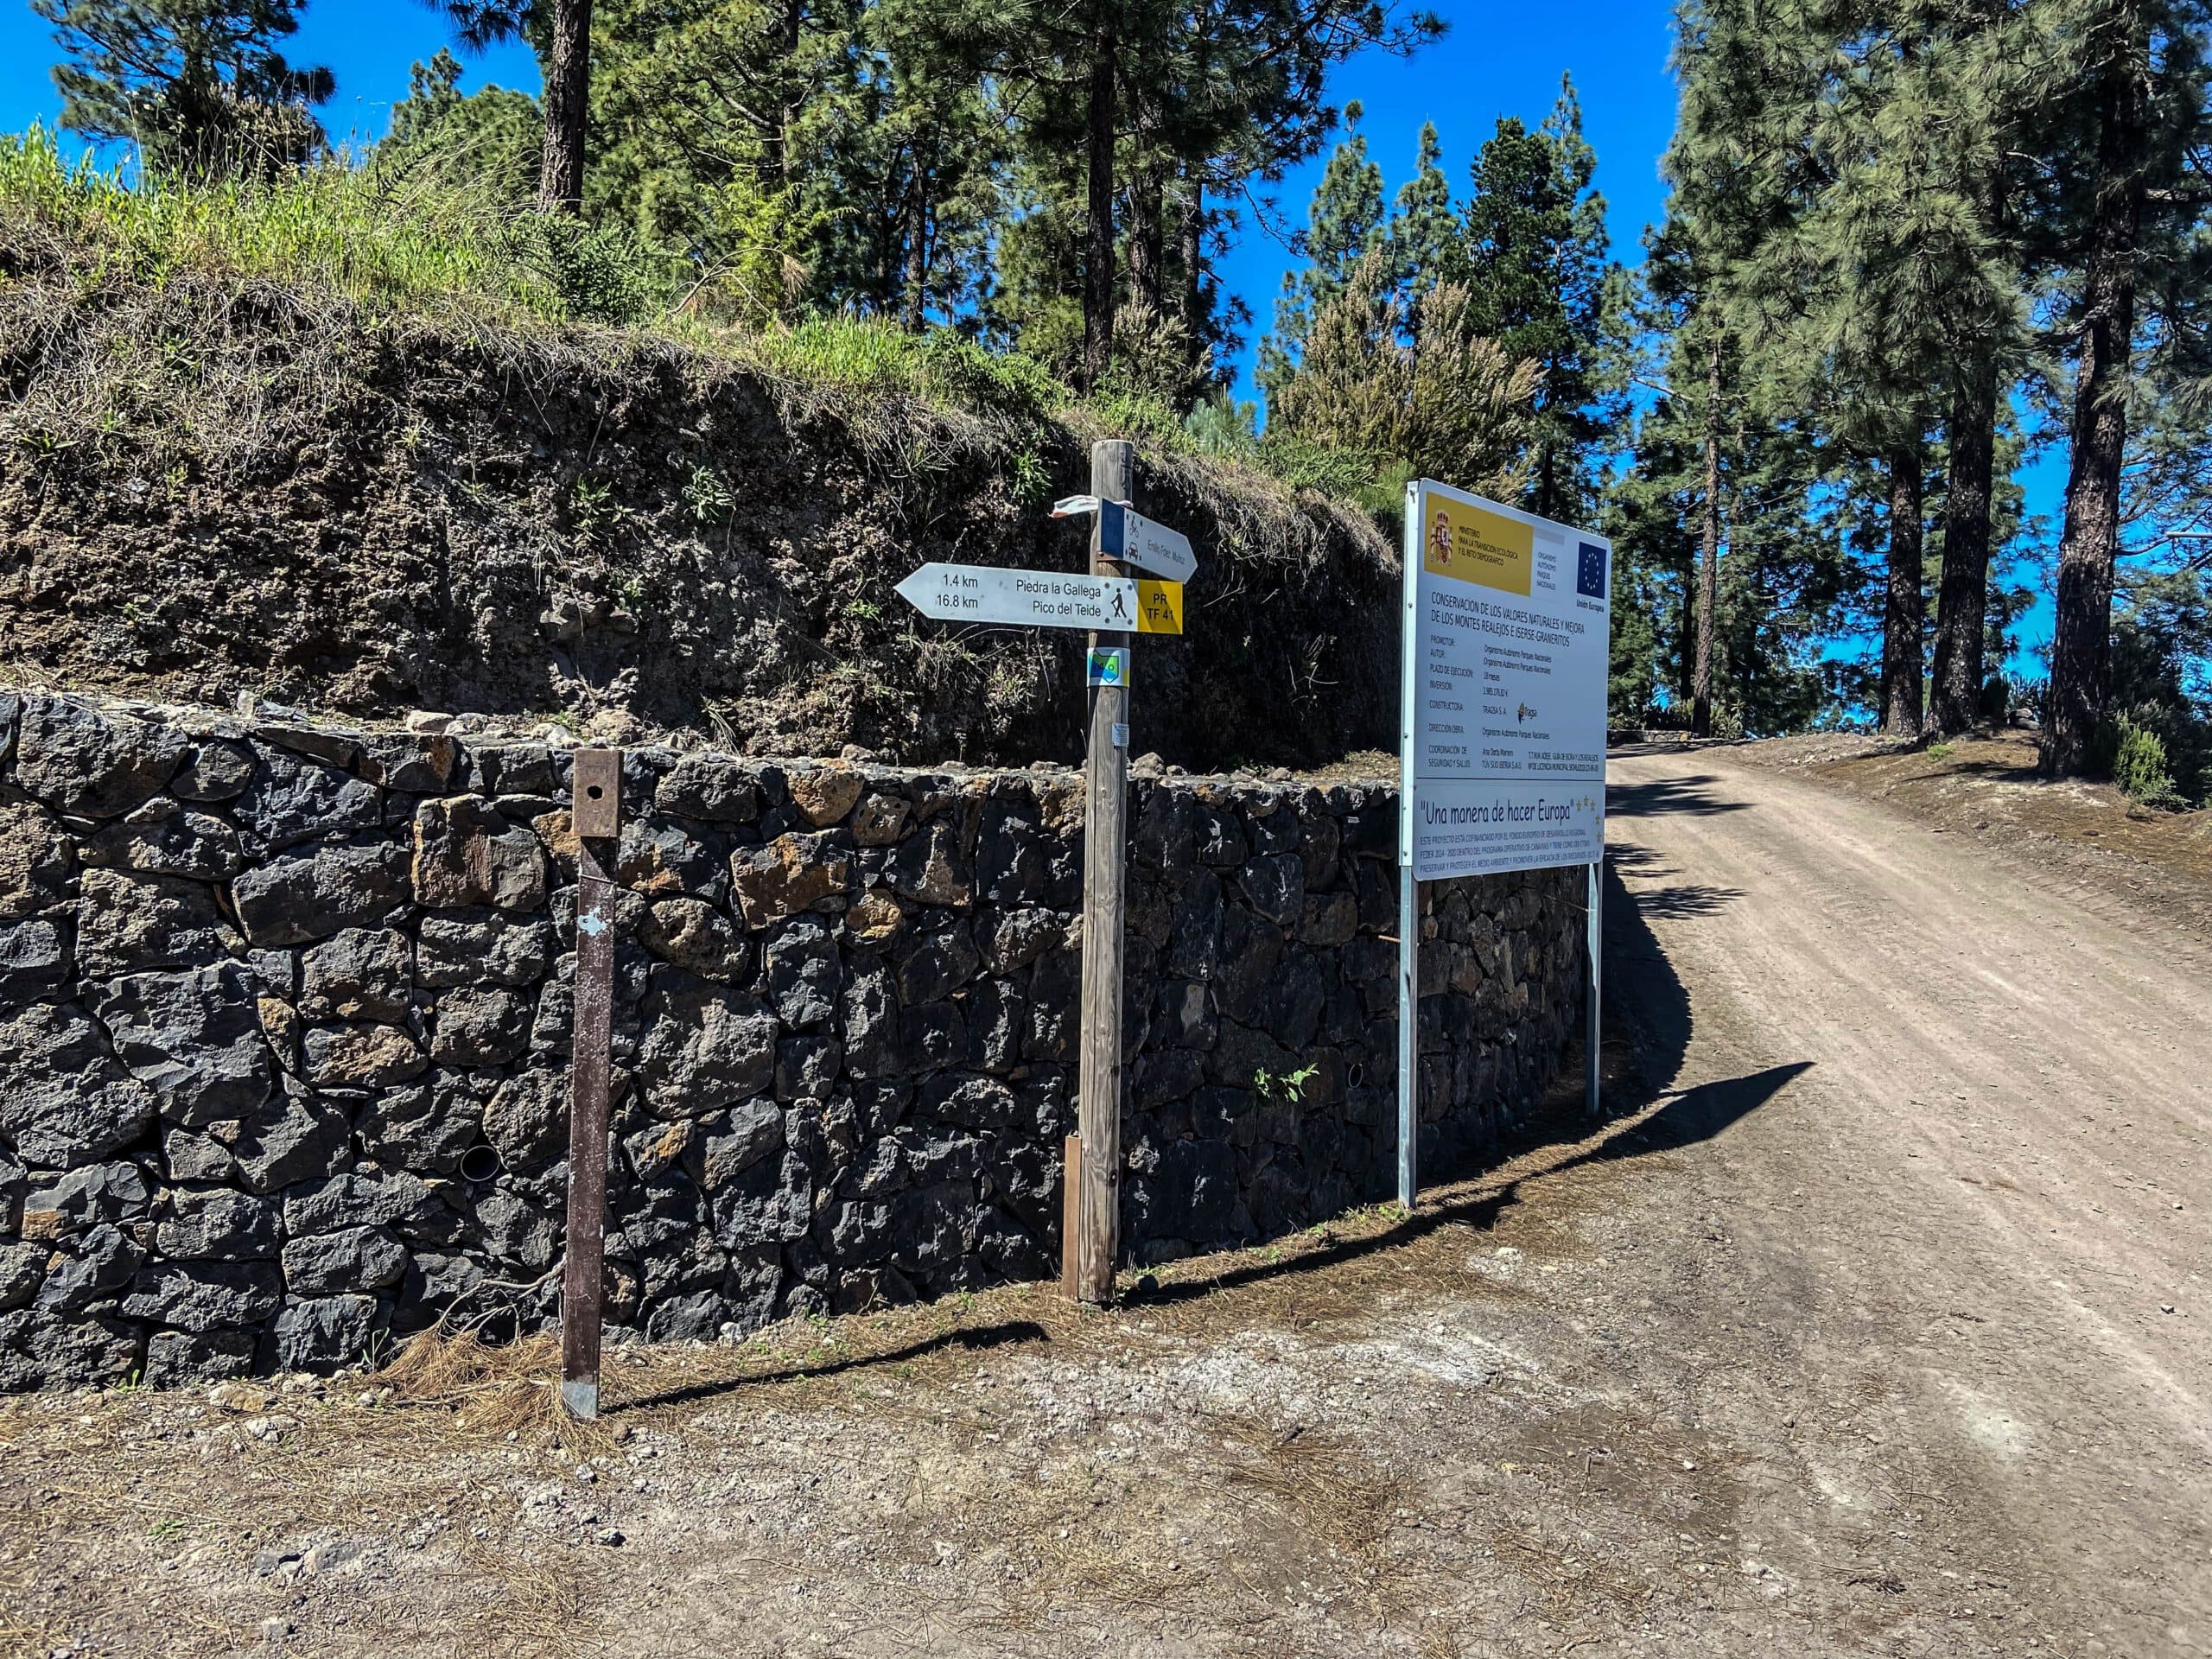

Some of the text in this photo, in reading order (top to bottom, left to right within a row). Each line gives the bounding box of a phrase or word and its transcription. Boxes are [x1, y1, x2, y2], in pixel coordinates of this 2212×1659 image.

[943, 574, 978, 589] 1.4 km
[1016, 579, 1101, 601] Piedra la Gallega
[937, 594, 978, 610] 16.8 km
[1153, 594, 1168, 605] PR
[1576, 599, 1605, 613] Unión Europea
[1033, 601, 1102, 616] Pico del Teide
[1147, 608, 1174, 620] TF 41
[1480, 602, 1489, 615] DE
[1490, 605, 1502, 618] LOS
[1503, 607, 1528, 624] VALORES
[1529, 613, 1559, 630] NATURALES
[1566, 620, 1585, 635] MEJORA
[1431, 609, 1440, 622] DE
[1441, 612, 1453, 626] LOS
[1455, 614, 1480, 631] MONTES
[1482, 620, 1510, 638] REALEJOS
[1516, 627, 1570, 647] ISERSE-GRANERITOS
[1444, 665, 1450, 675] DE
[1421, 798, 1574, 827] "Una manera de hacer Europa"
